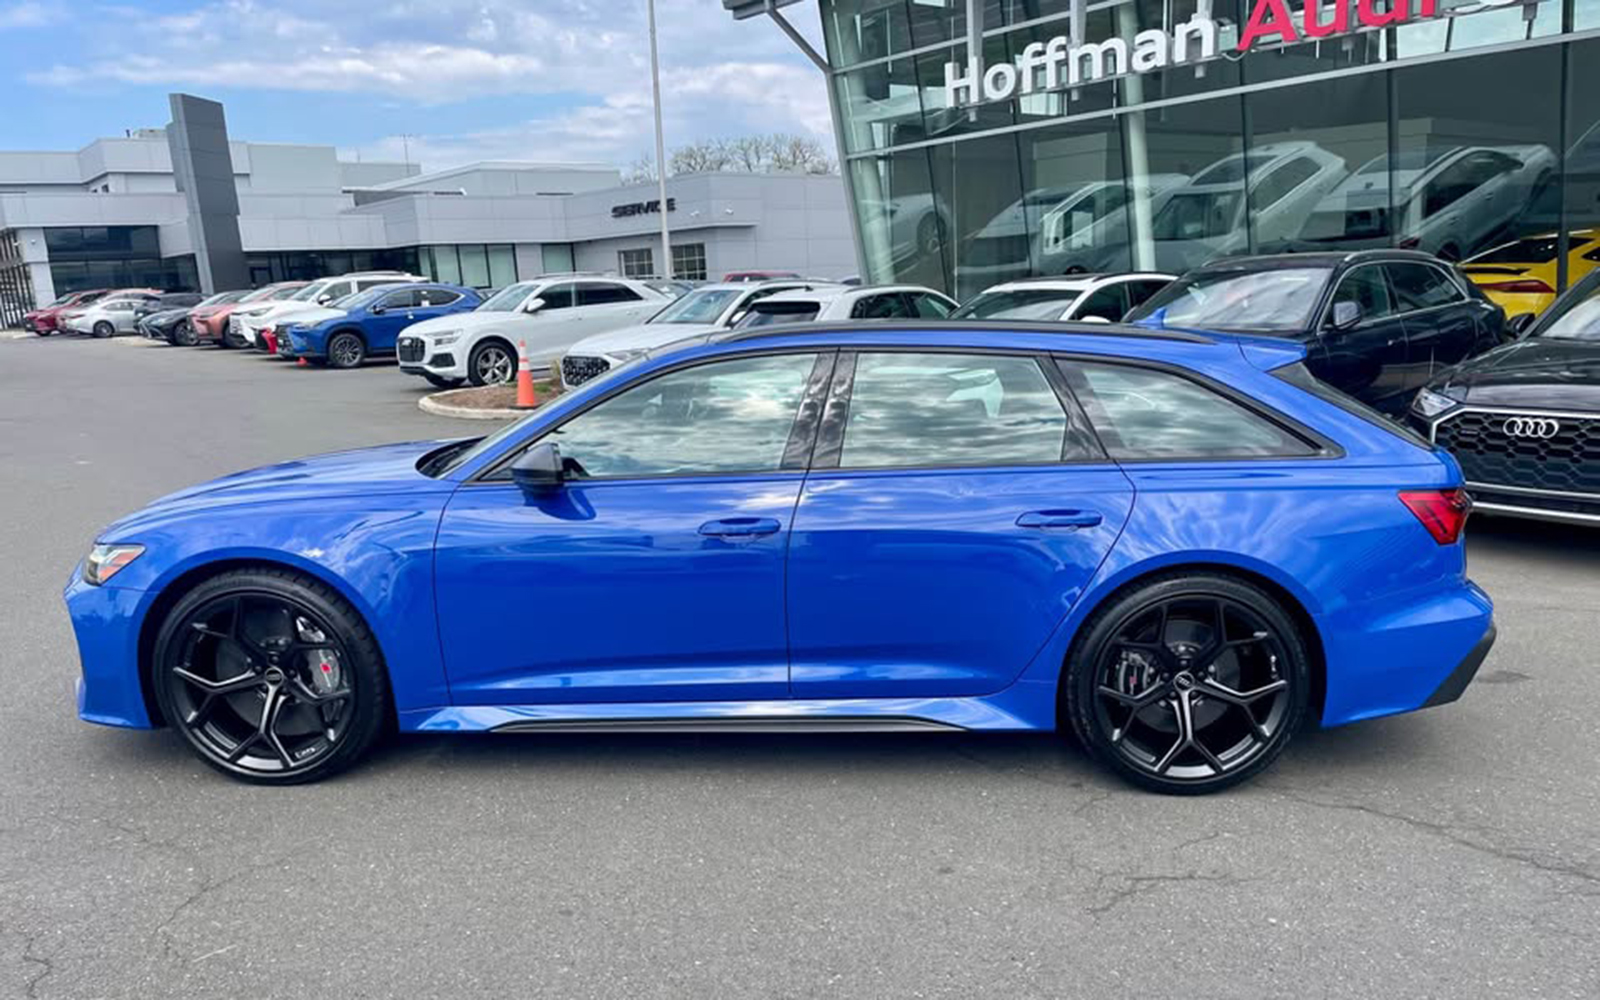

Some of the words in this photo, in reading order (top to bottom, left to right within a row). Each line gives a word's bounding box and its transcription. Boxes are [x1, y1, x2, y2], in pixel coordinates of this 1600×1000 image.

[944, 17, 1217, 108] Hoffman
[1236, 0, 1437, 51] Au
[611, 197, 676, 218] SERVICE
